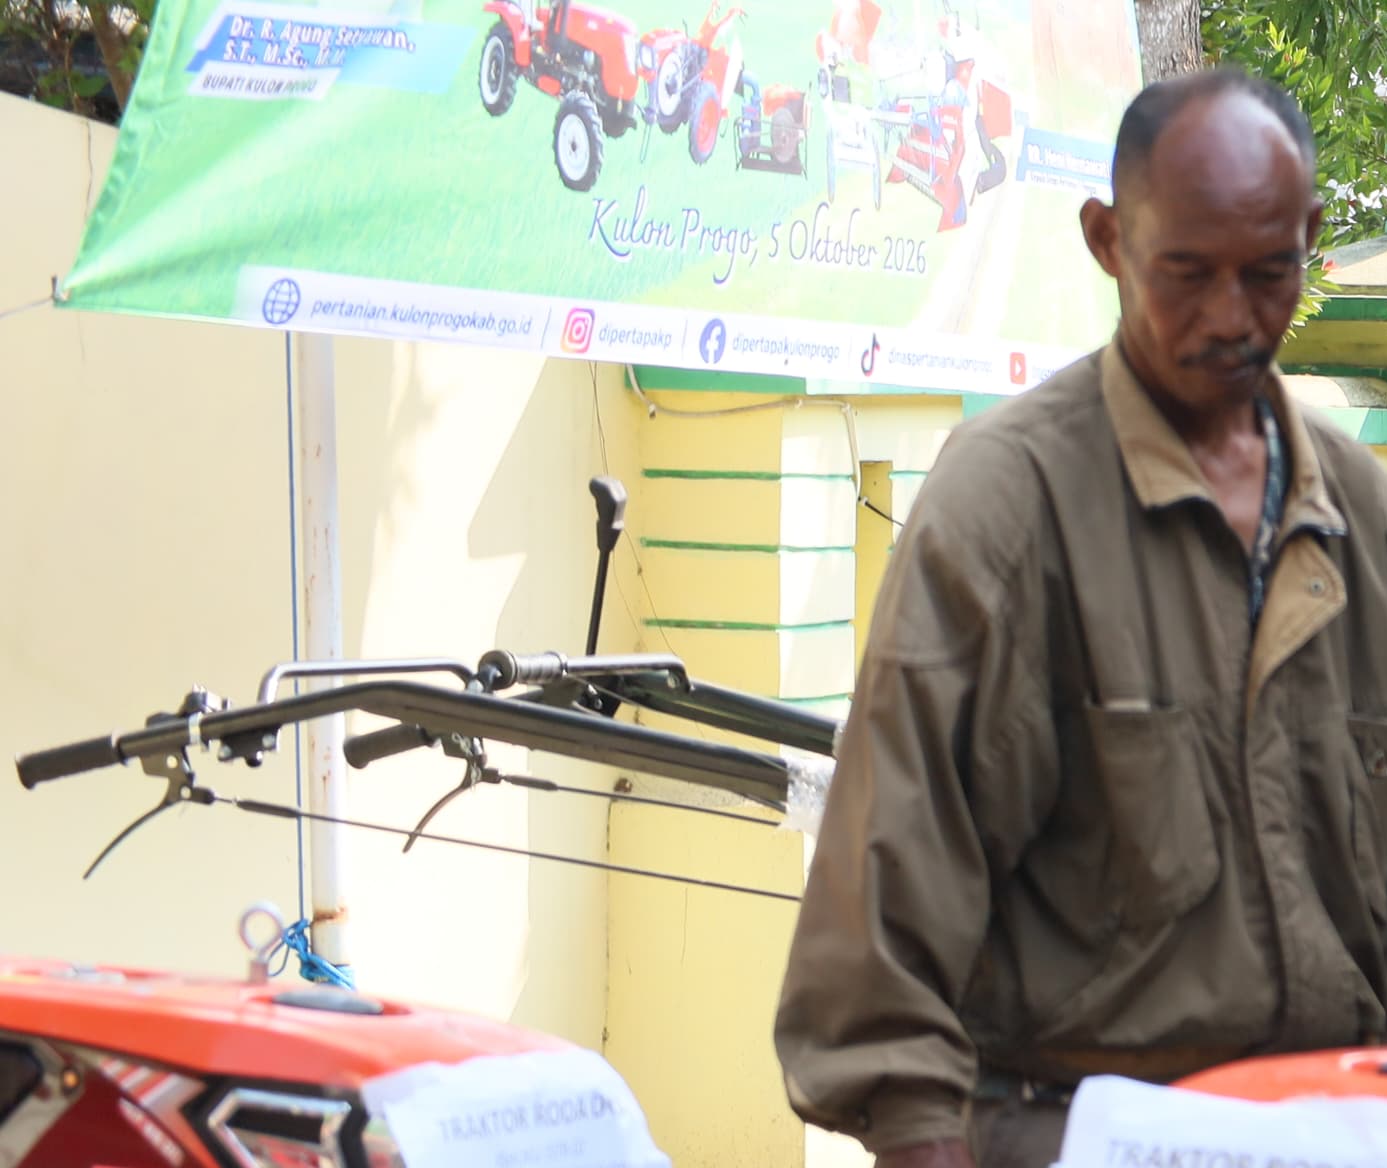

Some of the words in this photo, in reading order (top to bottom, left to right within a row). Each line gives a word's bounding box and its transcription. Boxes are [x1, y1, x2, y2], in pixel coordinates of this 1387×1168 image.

[230, 16, 254, 38] Dr.
[260, 18, 276, 39] R.
[280, 20, 332, 48] Agung
[202, 73, 243, 91] BUPATI
[588, 184, 676, 257] Kulon
[681, 208, 758, 284] Progo,
[768, 222, 782, 258] 5
[789, 201, 879, 268] Oktober
[883, 236, 927, 275] 2026
[310, 298, 533, 337] pertanian.kulonprogokab.go.id
